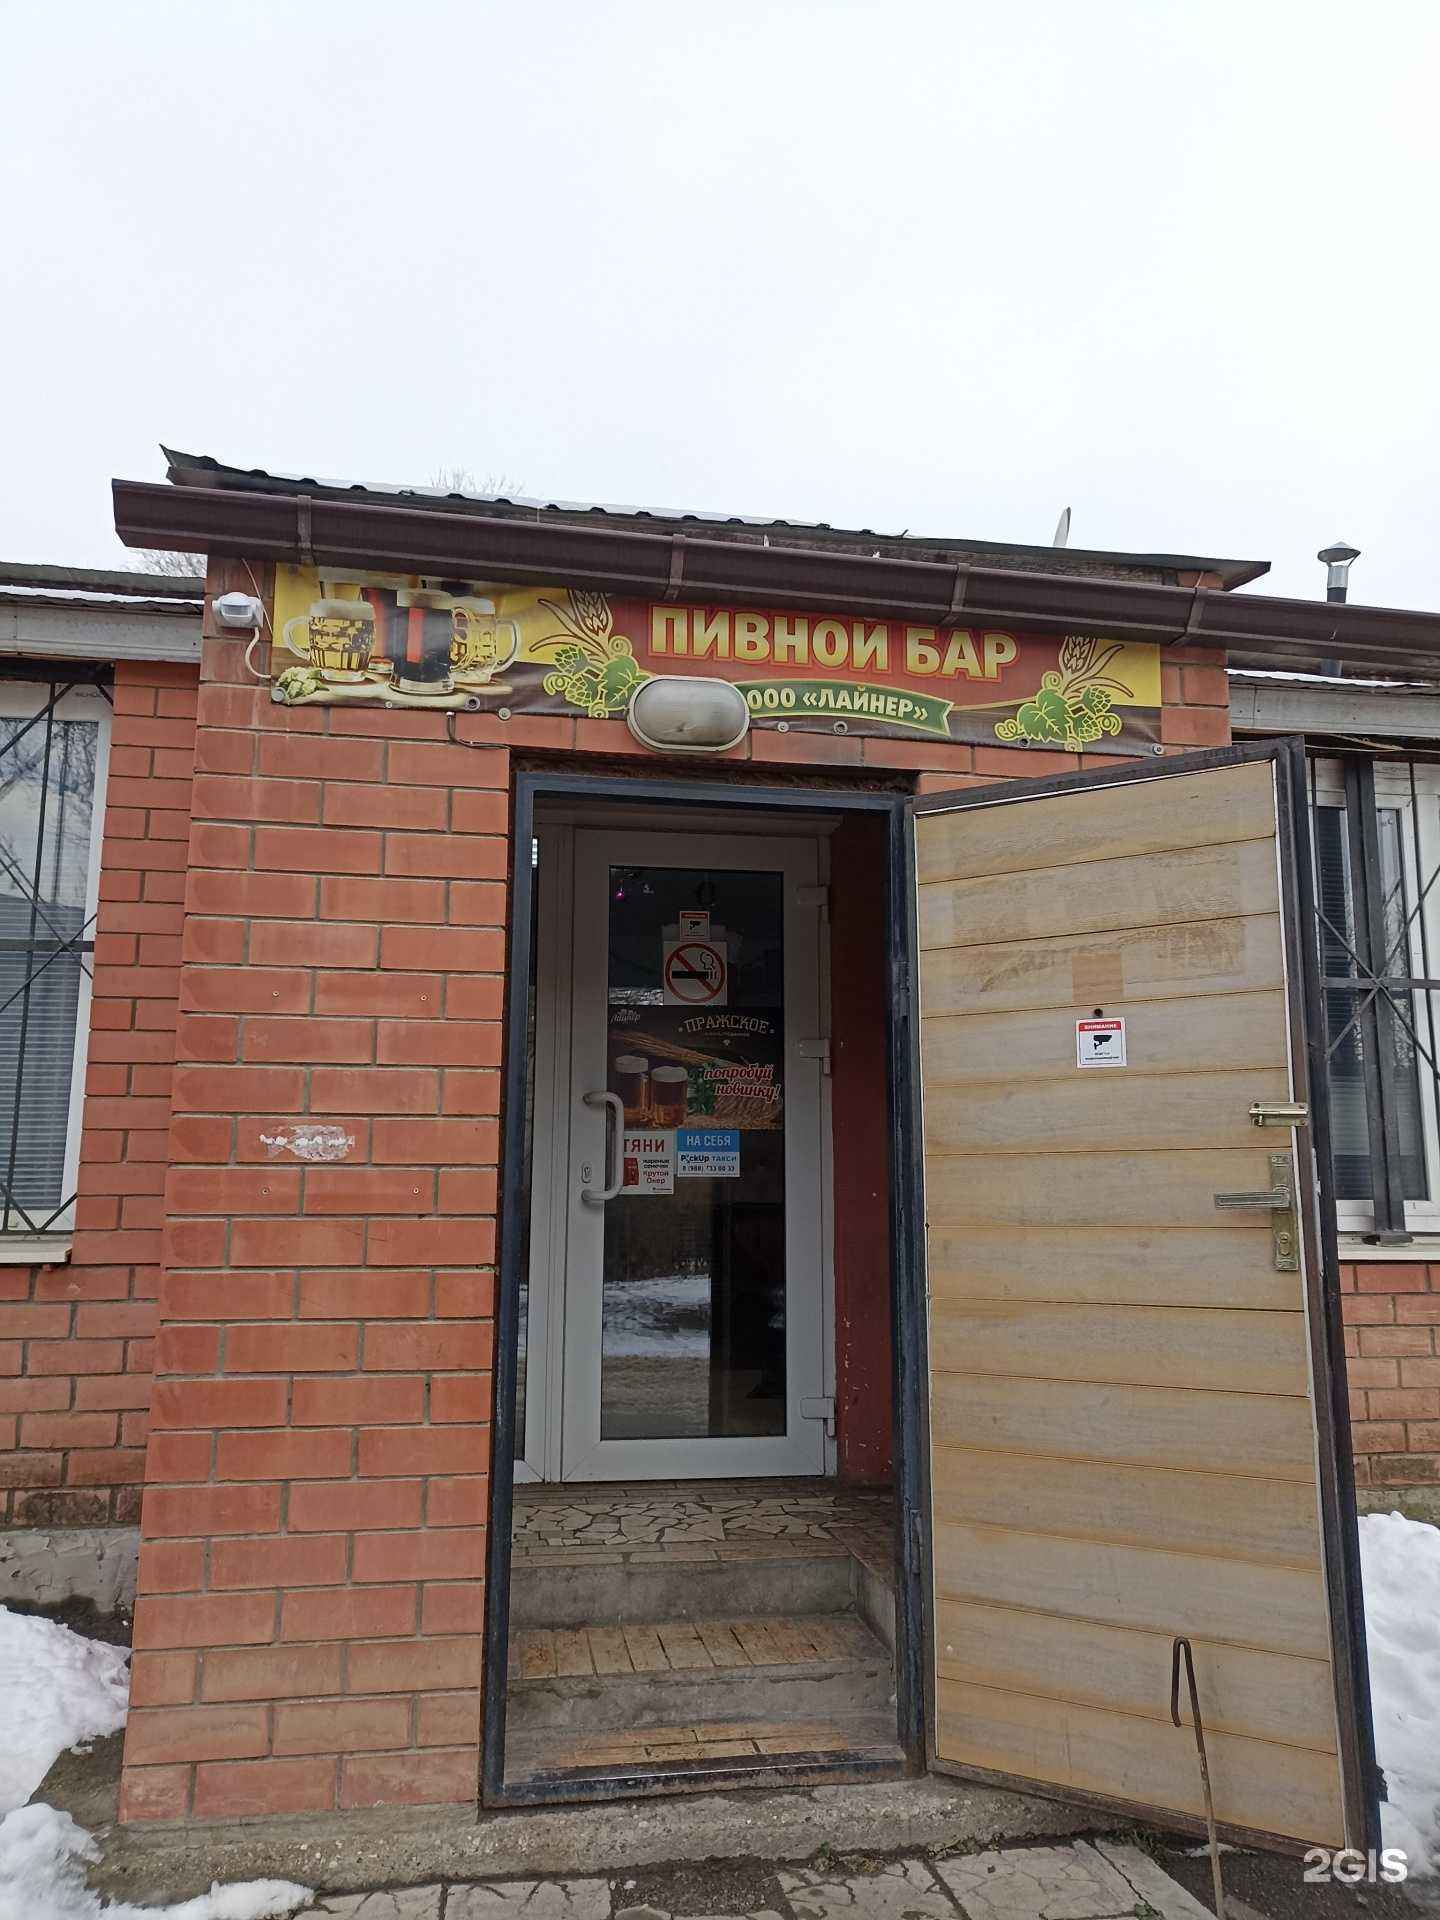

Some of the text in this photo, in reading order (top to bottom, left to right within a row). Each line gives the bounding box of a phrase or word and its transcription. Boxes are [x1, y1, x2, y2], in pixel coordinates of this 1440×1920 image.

[905, 626, 1017, 678] БАР
[747, 686, 928, 721] ООО «ЛАЙНЕР»
[684, 1014, 769, 1034] ПРАЖСКОЕ
[704, 1064, 774, 1082] попробуй
[715, 1083, 781, 1103] новинку!
[686, 1135, 731, 1146] НА СЕБЯ
